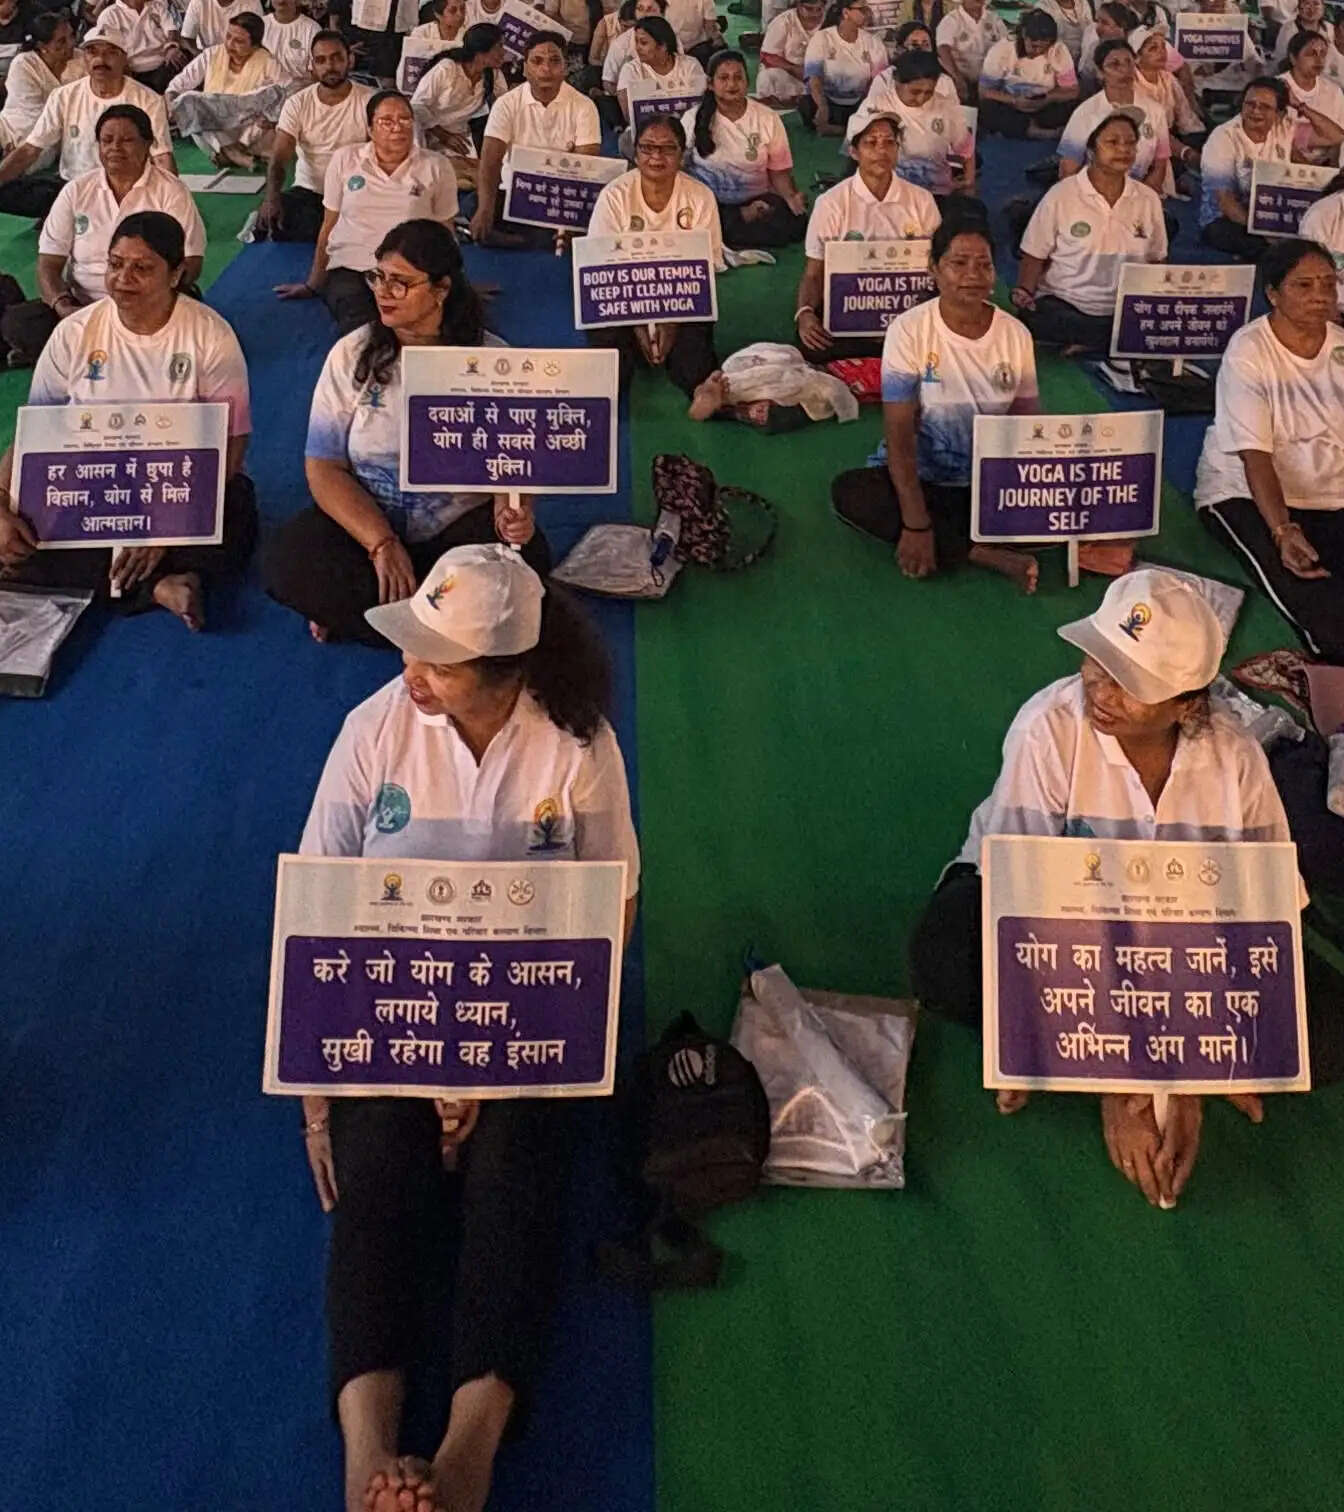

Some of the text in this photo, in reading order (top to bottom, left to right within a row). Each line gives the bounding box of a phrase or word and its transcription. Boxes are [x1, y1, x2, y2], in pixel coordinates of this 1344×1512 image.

[583, 265, 706, 285] BODY IS OUR TEMPLE,
[857, 276, 934, 292] YOGA IS THE
[590, 282, 700, 301] KEEP IT CLEAN AND
[843, 294, 901, 313] JOURNEY
[598, 297, 695, 316] SAFE WITH YOGA
[428, 401, 591, 430] दवाओं से पाए मुक्ति,
[433, 426, 587, 452] योग ही सबसे अच्छी
[47, 454, 193, 483] हर आसन में छुपा है
[485, 453, 532, 481] युक्ति।
[1017, 461, 1123, 483] YOGA IS THE
[46, 481, 191, 508] विज्ञान, योग से मिले
[998, 484, 1138, 511] JOURNEY OF THE
[81, 514, 152, 533] आत्मज्ञान।
[1048, 511, 1090, 531] SELF
[1015, 932, 1279, 979] योग का महत्व जानें, इसे
[313, 949, 583, 990] करे जो योग के आसन,
[375, 991, 518, 1030] लगाये ध्यान,
[1040, 978, 1260, 1023] अपने जीवन का एक
[322, 1029, 566, 1071] सुखी रहेगा वह इंसान
[1056, 1022, 1248, 1065] अभिन्न अंग माने।
